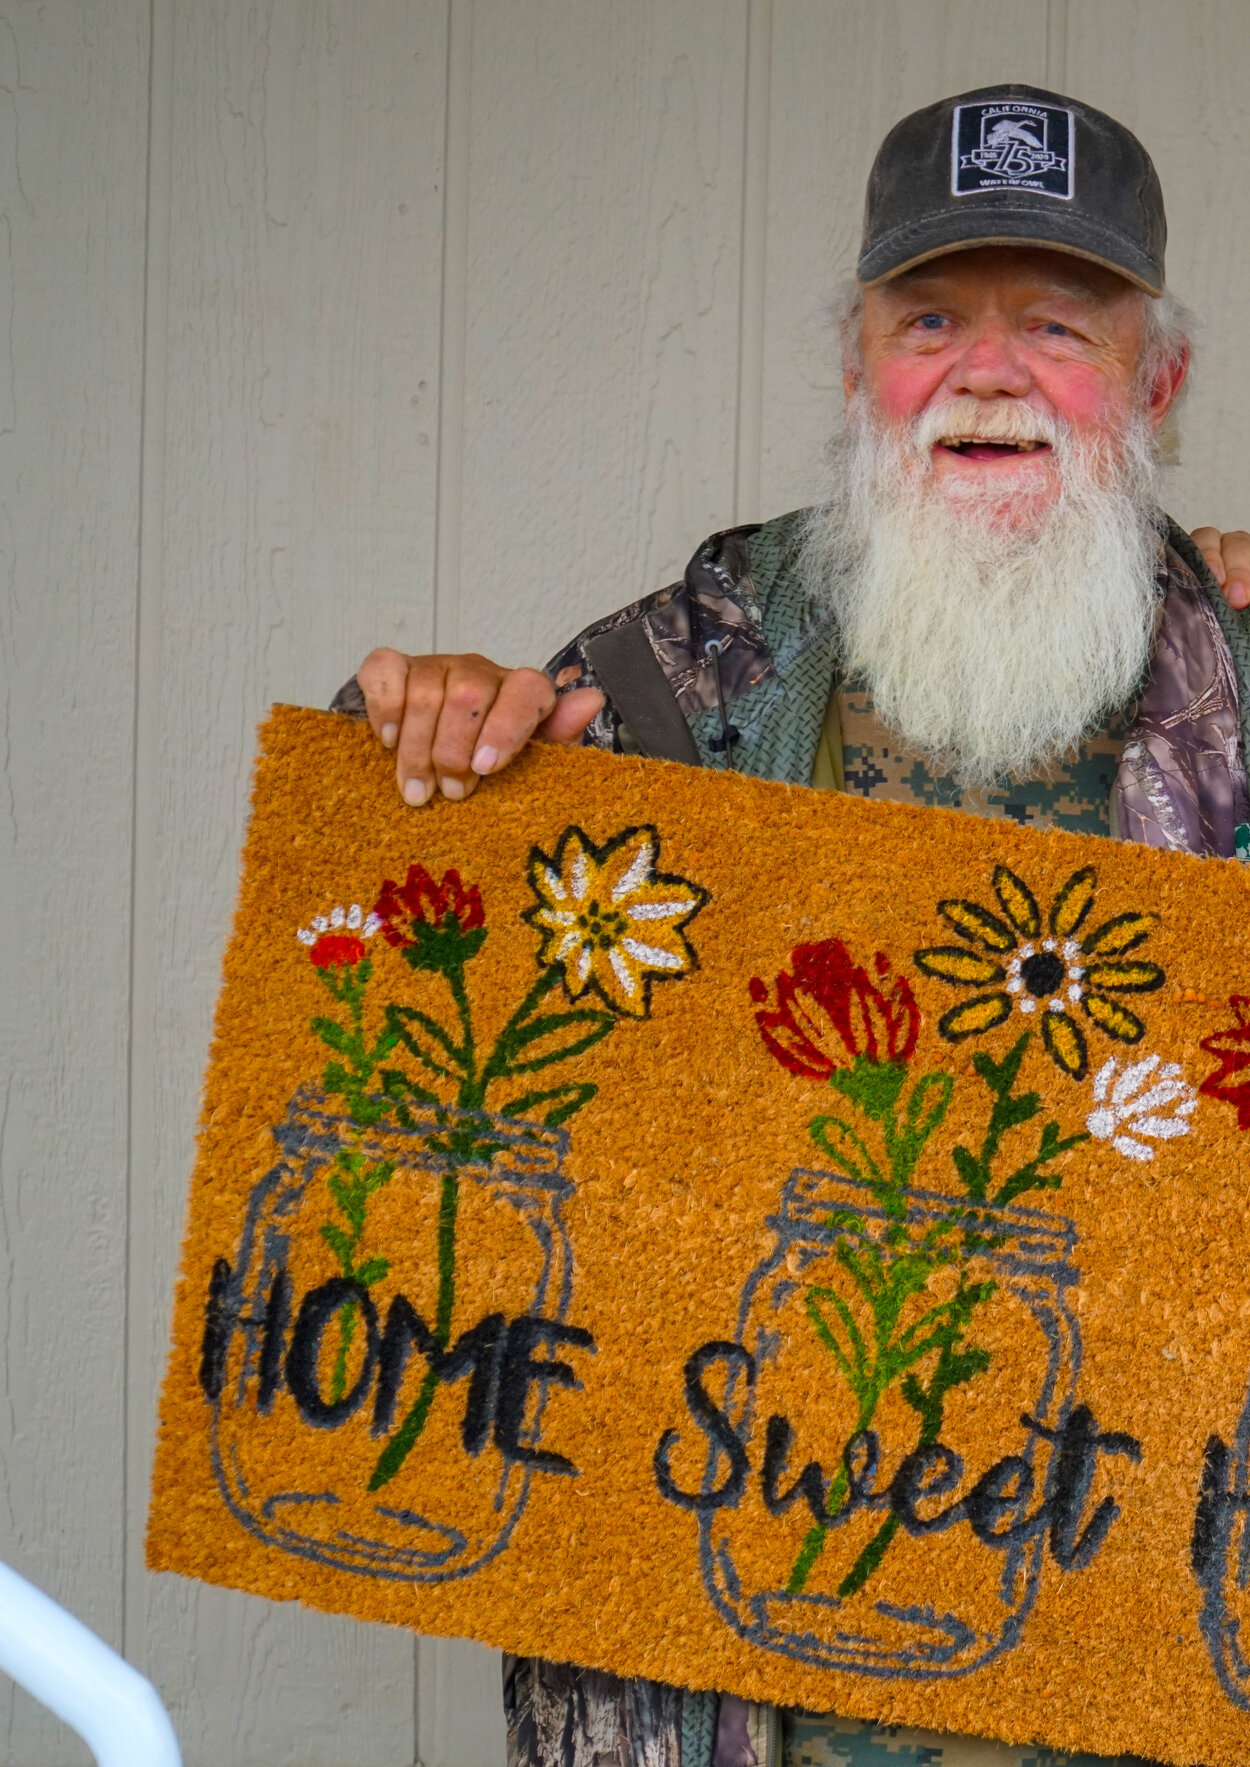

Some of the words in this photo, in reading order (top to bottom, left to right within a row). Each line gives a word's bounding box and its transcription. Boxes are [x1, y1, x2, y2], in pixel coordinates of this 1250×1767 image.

[981, 105, 1048, 118] CALIFORNIA
[993, 140, 1034, 176] 75
[979, 179, 1045, 188] WATERFOWL
[200, 1257, 598, 1478] HOME
[653, 1340, 1145, 1570] Sweet
